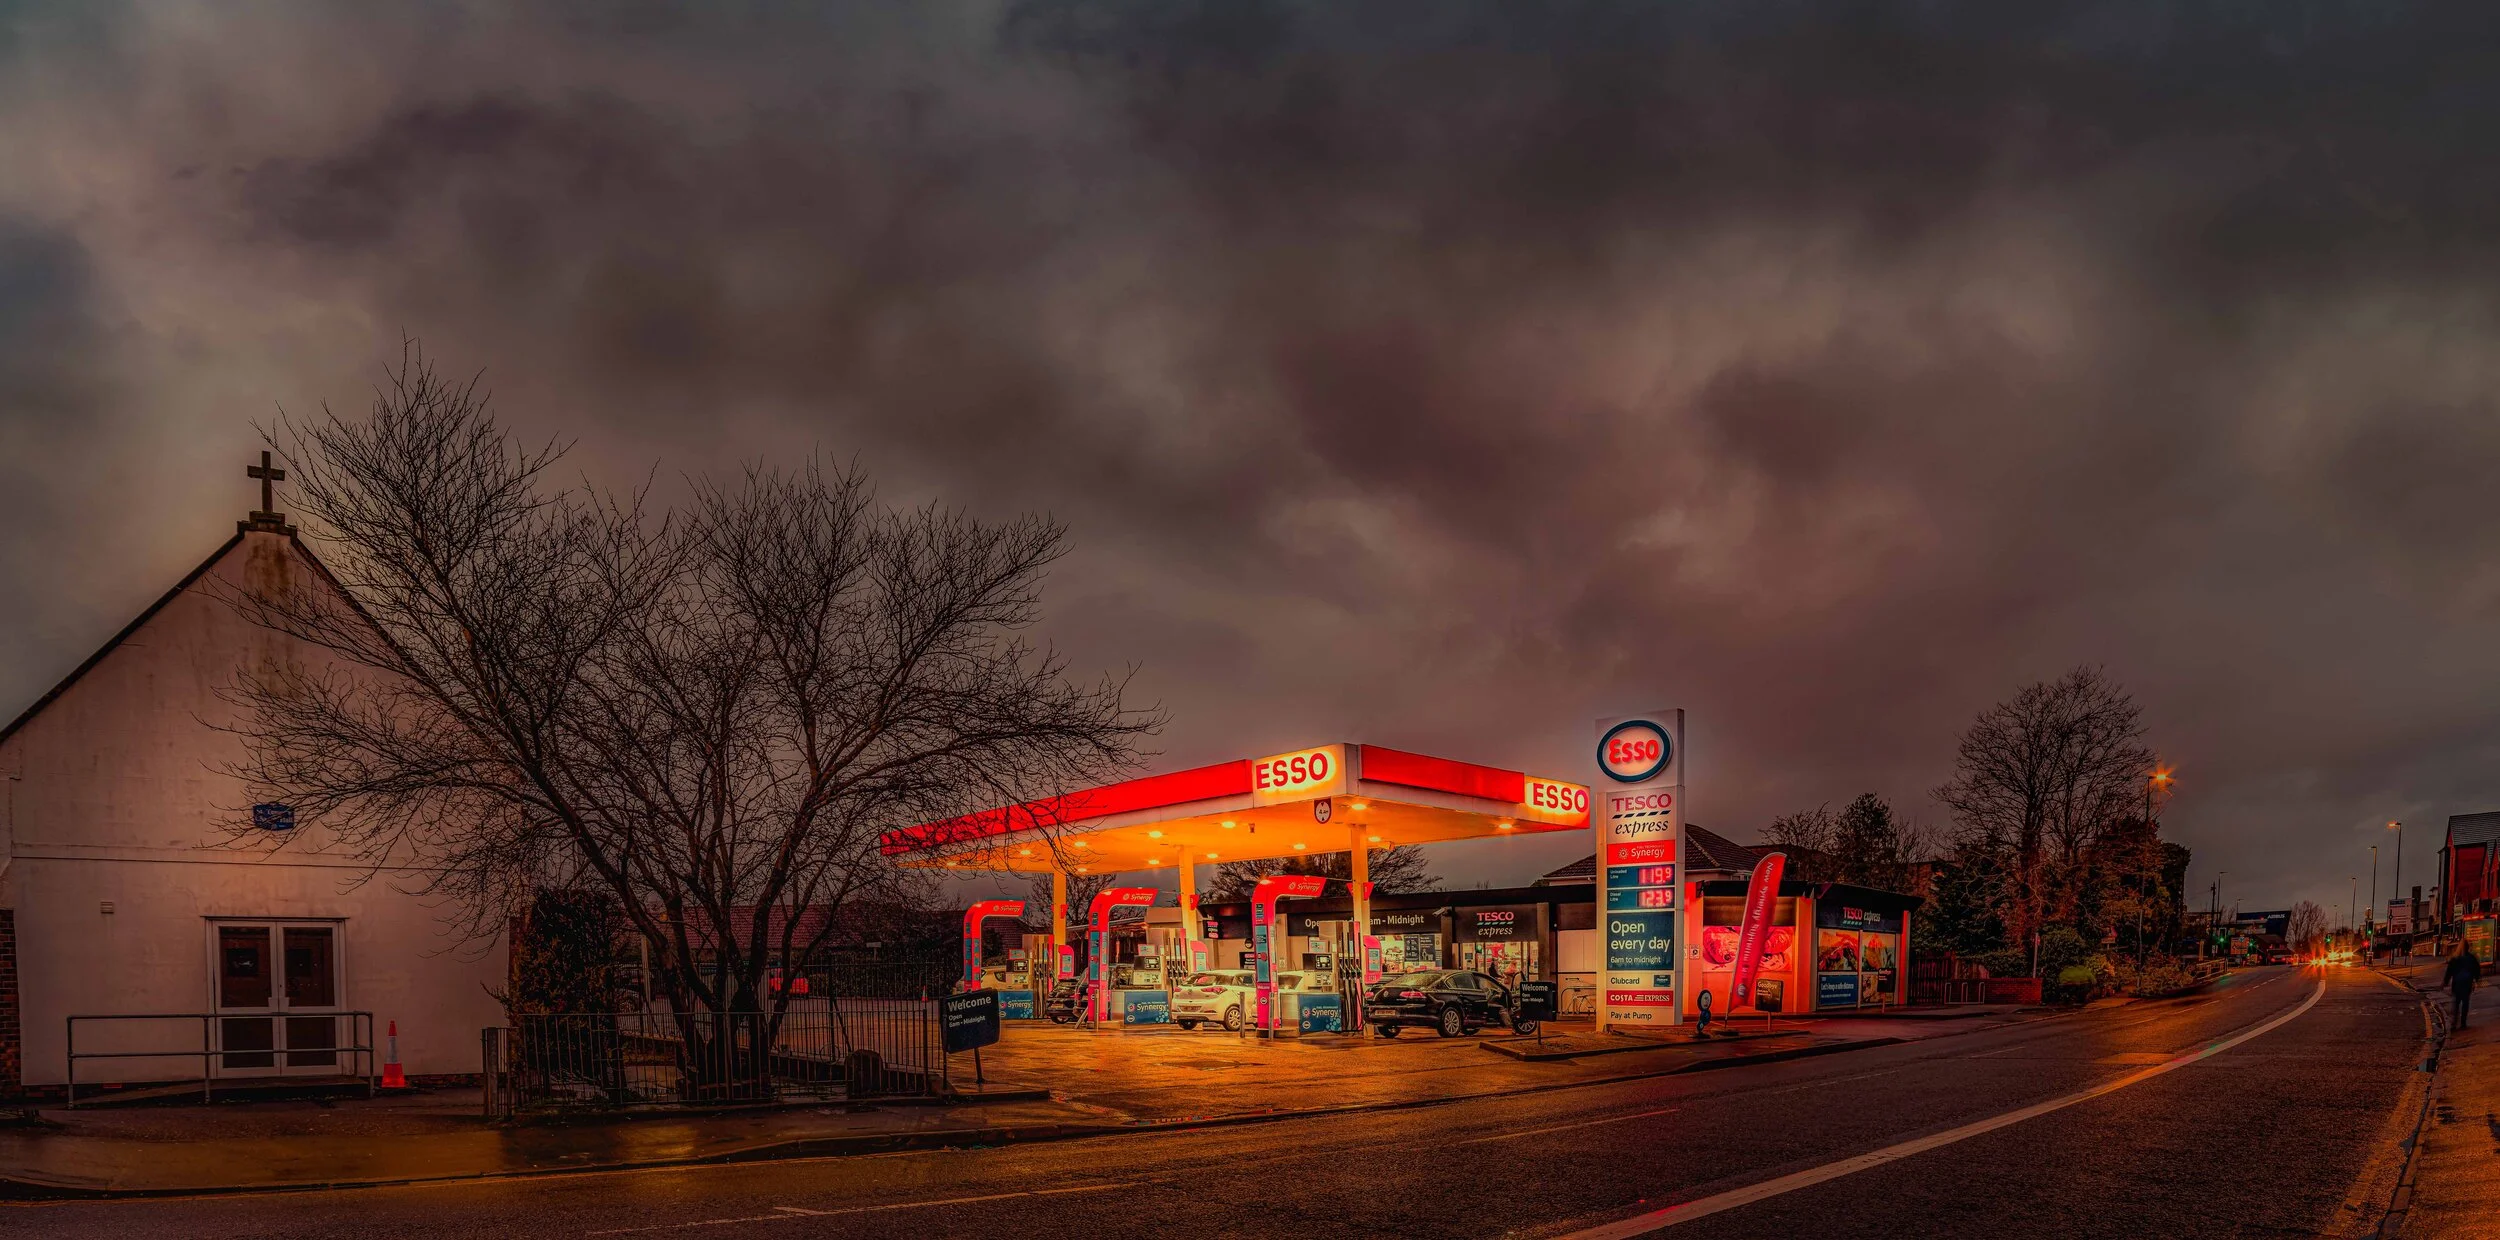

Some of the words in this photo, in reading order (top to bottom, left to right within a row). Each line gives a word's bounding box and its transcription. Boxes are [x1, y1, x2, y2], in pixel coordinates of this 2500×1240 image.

[1255, 752, 1328, 789] ESSO
[1533, 783, 1588, 813] ESSO
[1611, 793, 1672, 812] TESCO
[1615, 820, 1669, 837] express
[1631, 848, 1664, 859] Synergy
[1764, 862, 1774, 884] New
[1476, 912, 1514, 921] TESCO
[1842, 907, 1862, 920] TESCO
[1304, 918, 1320, 929] Ope
[1387, 914, 1424, 926] Midnight
[1611, 920, 1645, 936] Open
[1478, 926, 1513, 938] express
[1610, 939, 1645, 953] every
[1648, 936, 1670, 952] day
[1634, 956, 1661, 964] midnight
[947, 996, 991, 1012] Welcome
[1008, 1001, 1031, 1009] Synergy
[963, 1015, 986, 1024] Midnight
[1311, 1007, 1338, 1018] Synergy
[1633, 1012, 1652, 1020] Pump
